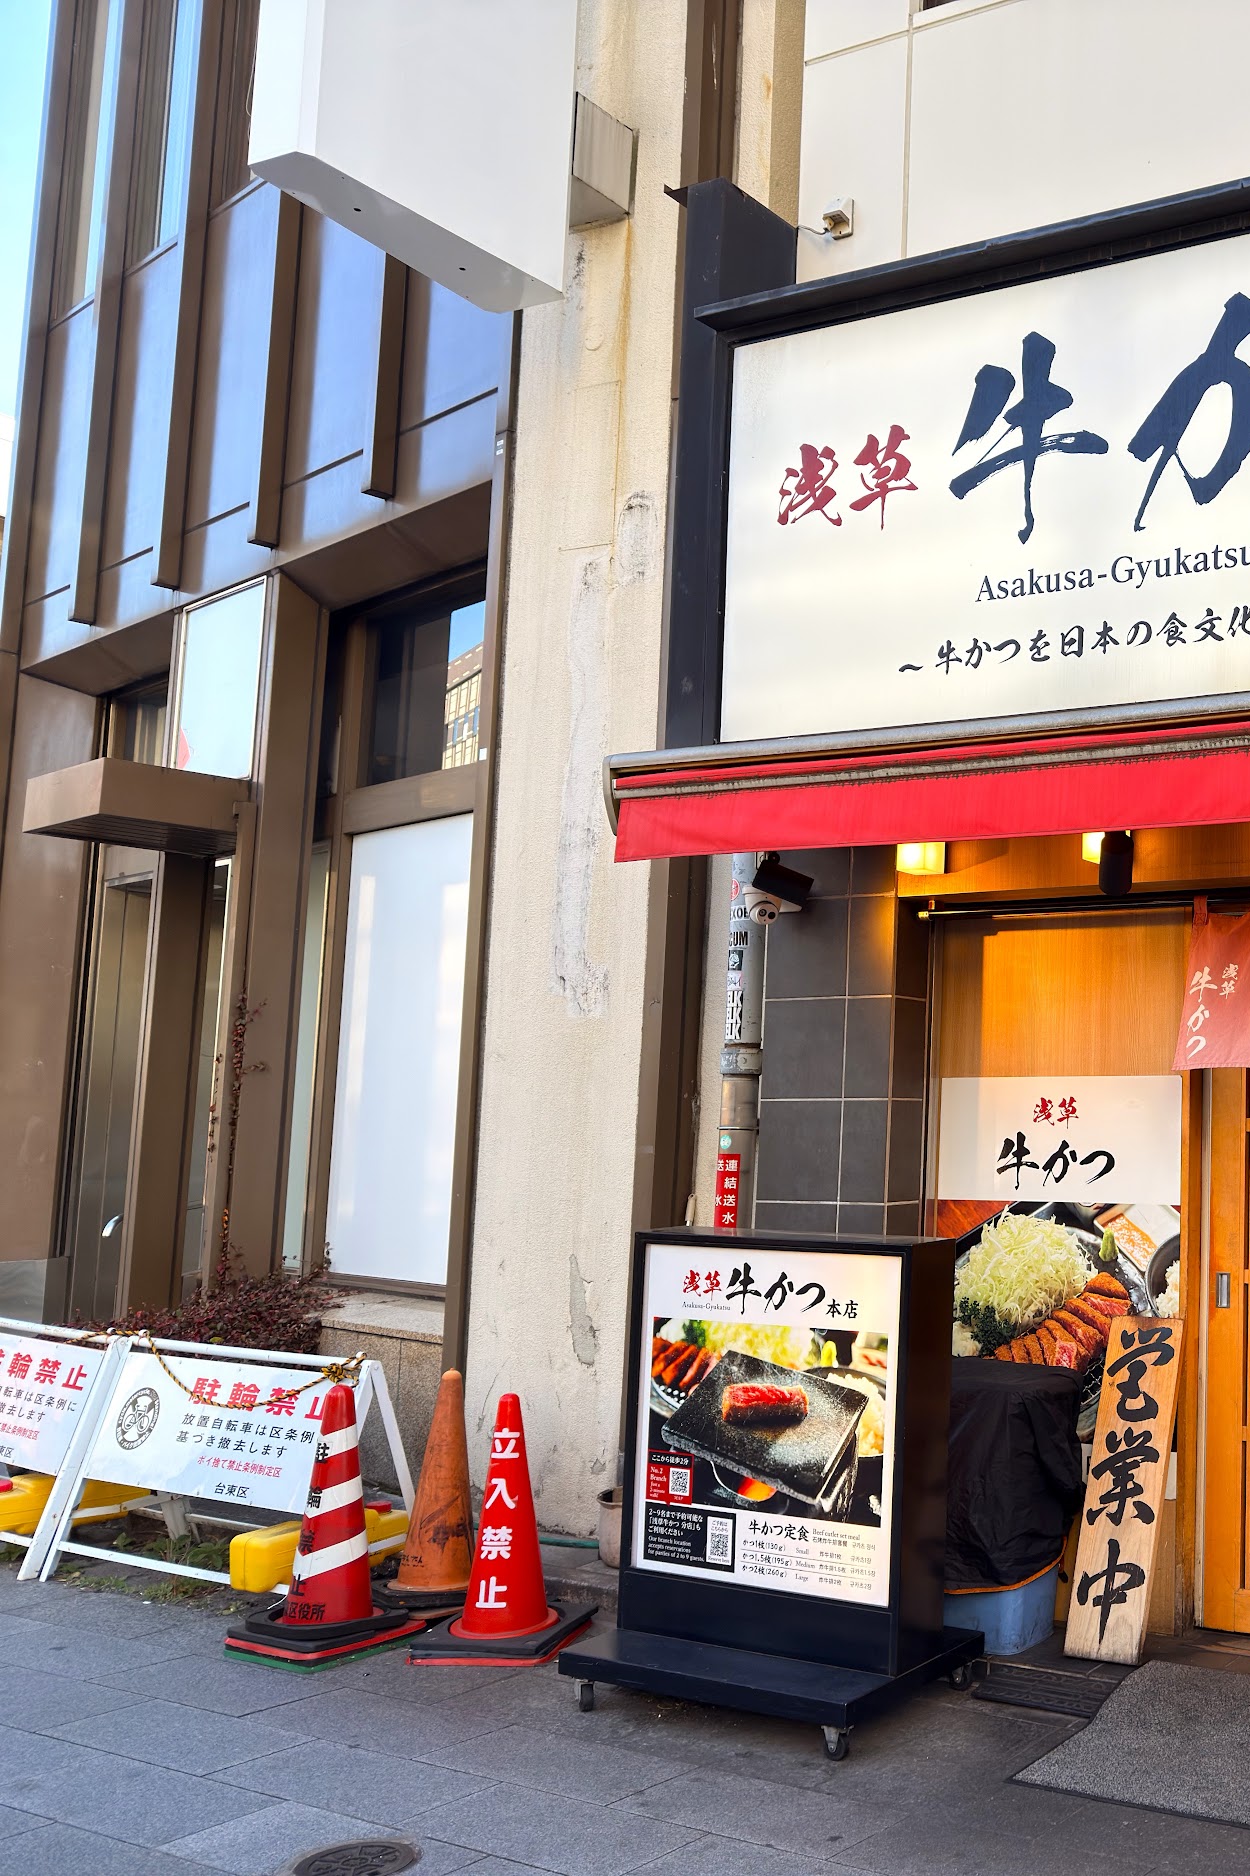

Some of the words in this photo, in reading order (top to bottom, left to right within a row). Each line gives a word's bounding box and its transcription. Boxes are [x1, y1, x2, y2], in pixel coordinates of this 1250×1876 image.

[777, 423, 918, 531] 浅草
[1219, 963, 1239, 999] 浅草
[1185, 966, 1218, 1060] 牛かつ
[1033, 1096, 1079, 1129] 浅草
[997, 1131, 1115, 1190] 牛かつ
[682, 1269, 723, 1301] 浅草
[726, 1262, 826, 1315] 牛かつ
[826, 1299, 859, 1319] 本店
[176, 1430, 288, 1458] 基づき撤去します
[214, 1482, 250, 1499] 台東区
[1076, 1326, 1175, 1645] 営業中
[475, 1427, 521, 1610] 立入禁止
[748, 1519, 809, 1542] 牛かつ定食
[796, 1547, 809, 1555] Small
[796, 1560, 815, 1569] Medium
